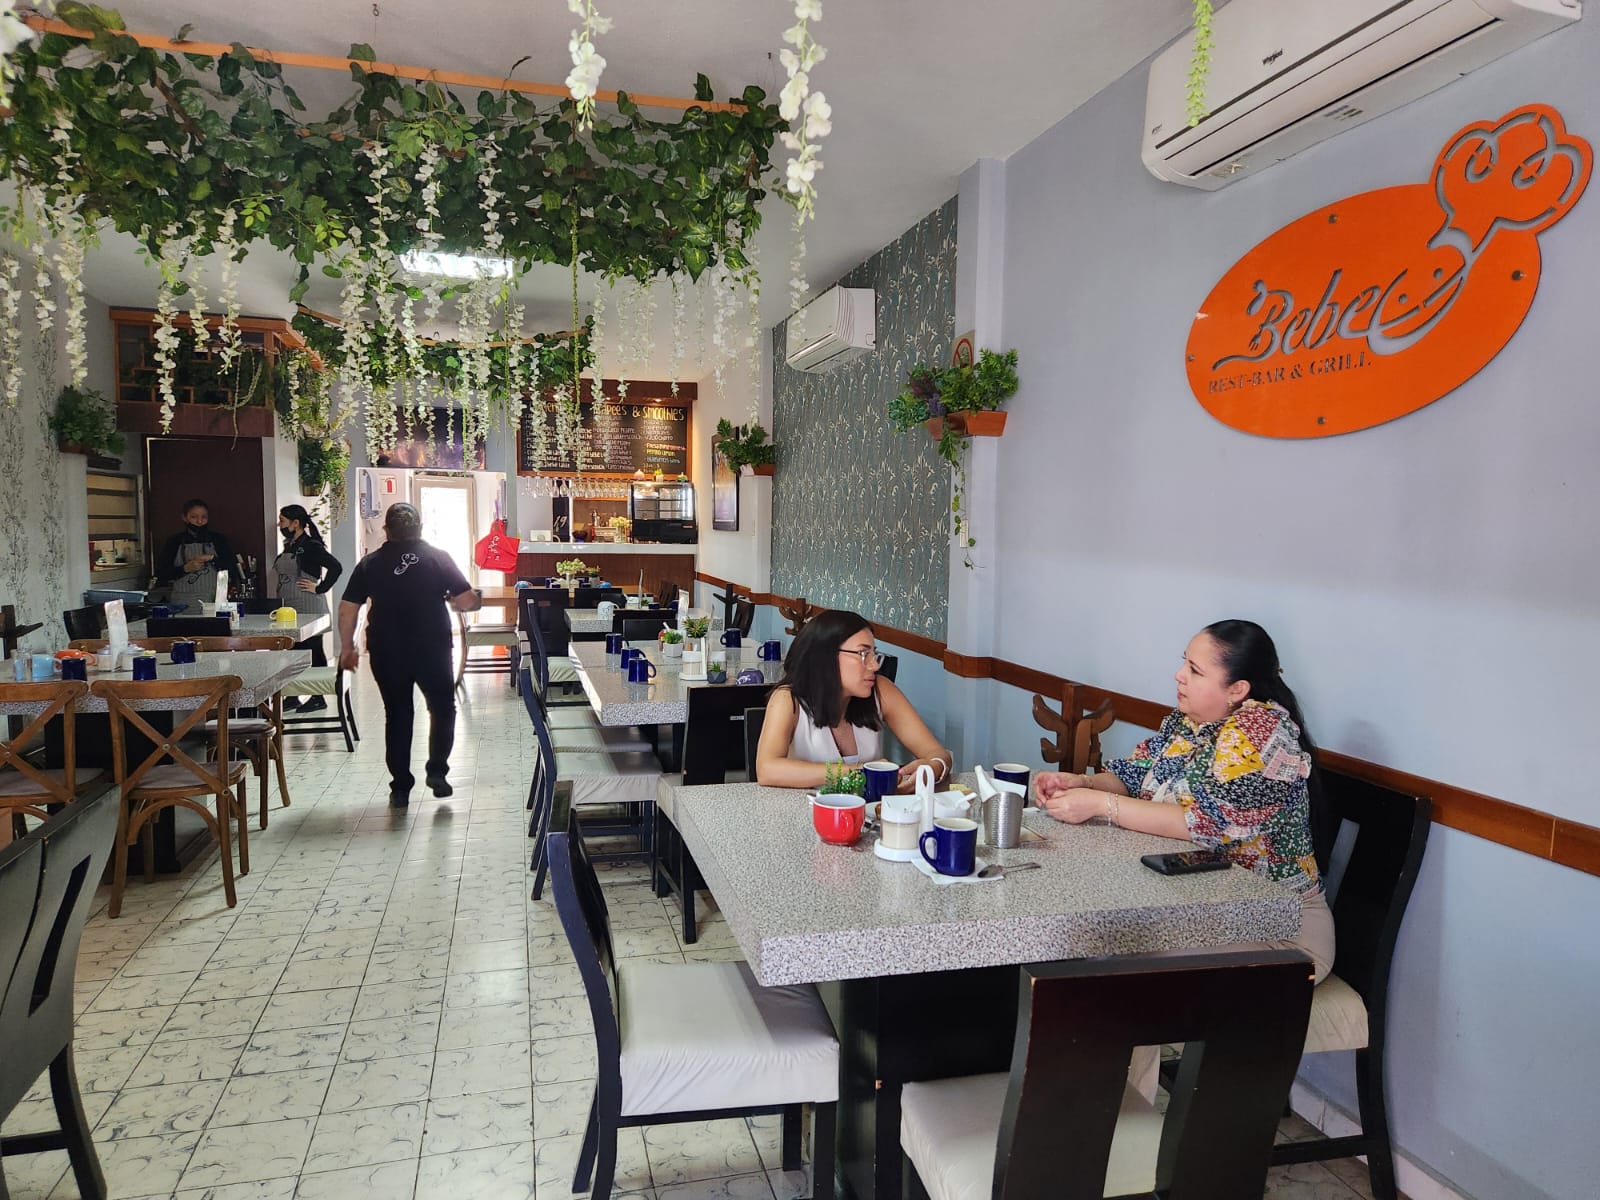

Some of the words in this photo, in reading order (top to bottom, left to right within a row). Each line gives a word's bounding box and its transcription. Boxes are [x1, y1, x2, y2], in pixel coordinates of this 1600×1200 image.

[1290, 363, 1303, 380] &
[1309, 352, 1372, 376] GRILL
[632, 406, 641, 418] &
